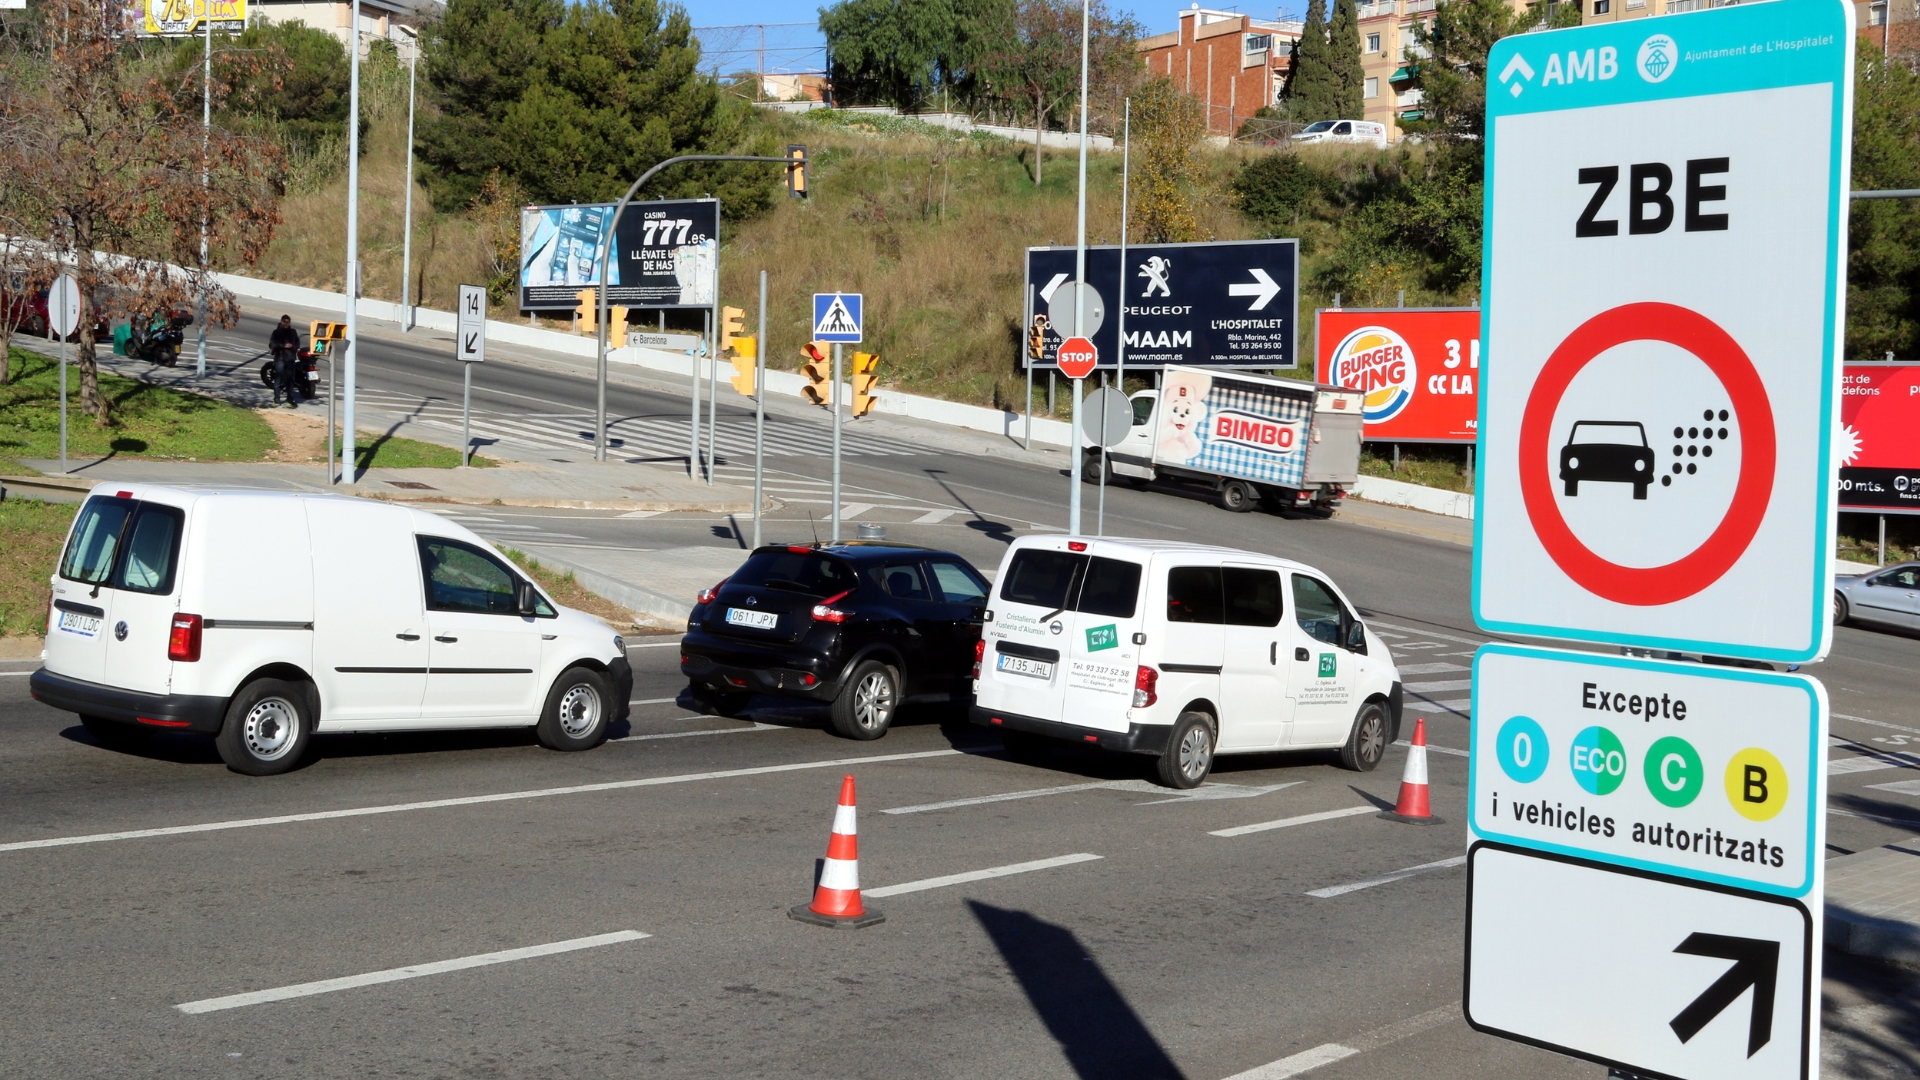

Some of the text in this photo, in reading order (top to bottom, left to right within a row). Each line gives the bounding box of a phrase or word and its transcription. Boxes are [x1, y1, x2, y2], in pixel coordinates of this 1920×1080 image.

[161, 22, 189, 31] DIRECTE
[1685, 34, 1833, 63] Ajuntament de L'Hospitalet
[1542, 46, 1619, 87] AMB
[1575, 157, 1730, 238] ZBE
[644, 211, 666, 219] CASINO
[643, 219, 706, 245] 777.es
[631, 248, 666, 260] LLÉVATE
[643, 261, 654, 270] DE
[466, 293, 478, 315] 14
[1211, 319, 1282, 329] L'HOSPITALET
[639, 334, 667, 345] Barcelona
[1123, 331, 1192, 348] MAAM
[1061, 352, 1093, 362] STOP
[1340, 345, 1403, 378] BURGER
[1444, 339, 1461, 368] 3
[1343, 361, 1405, 391] KING
[1856, 374, 1870, 384] de
[1179, 387, 1187, 396] B
[1428, 375, 1473, 394] CC LA
[1217, 416, 1294, 448] BIMBO
[1855, 480, 1884, 492] mts.
[83, 617, 100, 632] LDC
[732, 610, 775, 626] 0611 JPX
[1006, 613, 1036, 624] Cristalleria
[996, 621, 1017, 631] Fusteria
[1018, 625, 1046, 635] d'Alumini
[1004, 657, 1047, 676] 7135 JHL
[1073, 662, 1083, 670] Tel.
[1110, 668, 1119, 676] 52
[1582, 682, 1687, 722] Excepte
[1513, 732, 1769, 803] 0 ECO C B
[1492, 792, 1784, 868] i vehicles autoritzats
